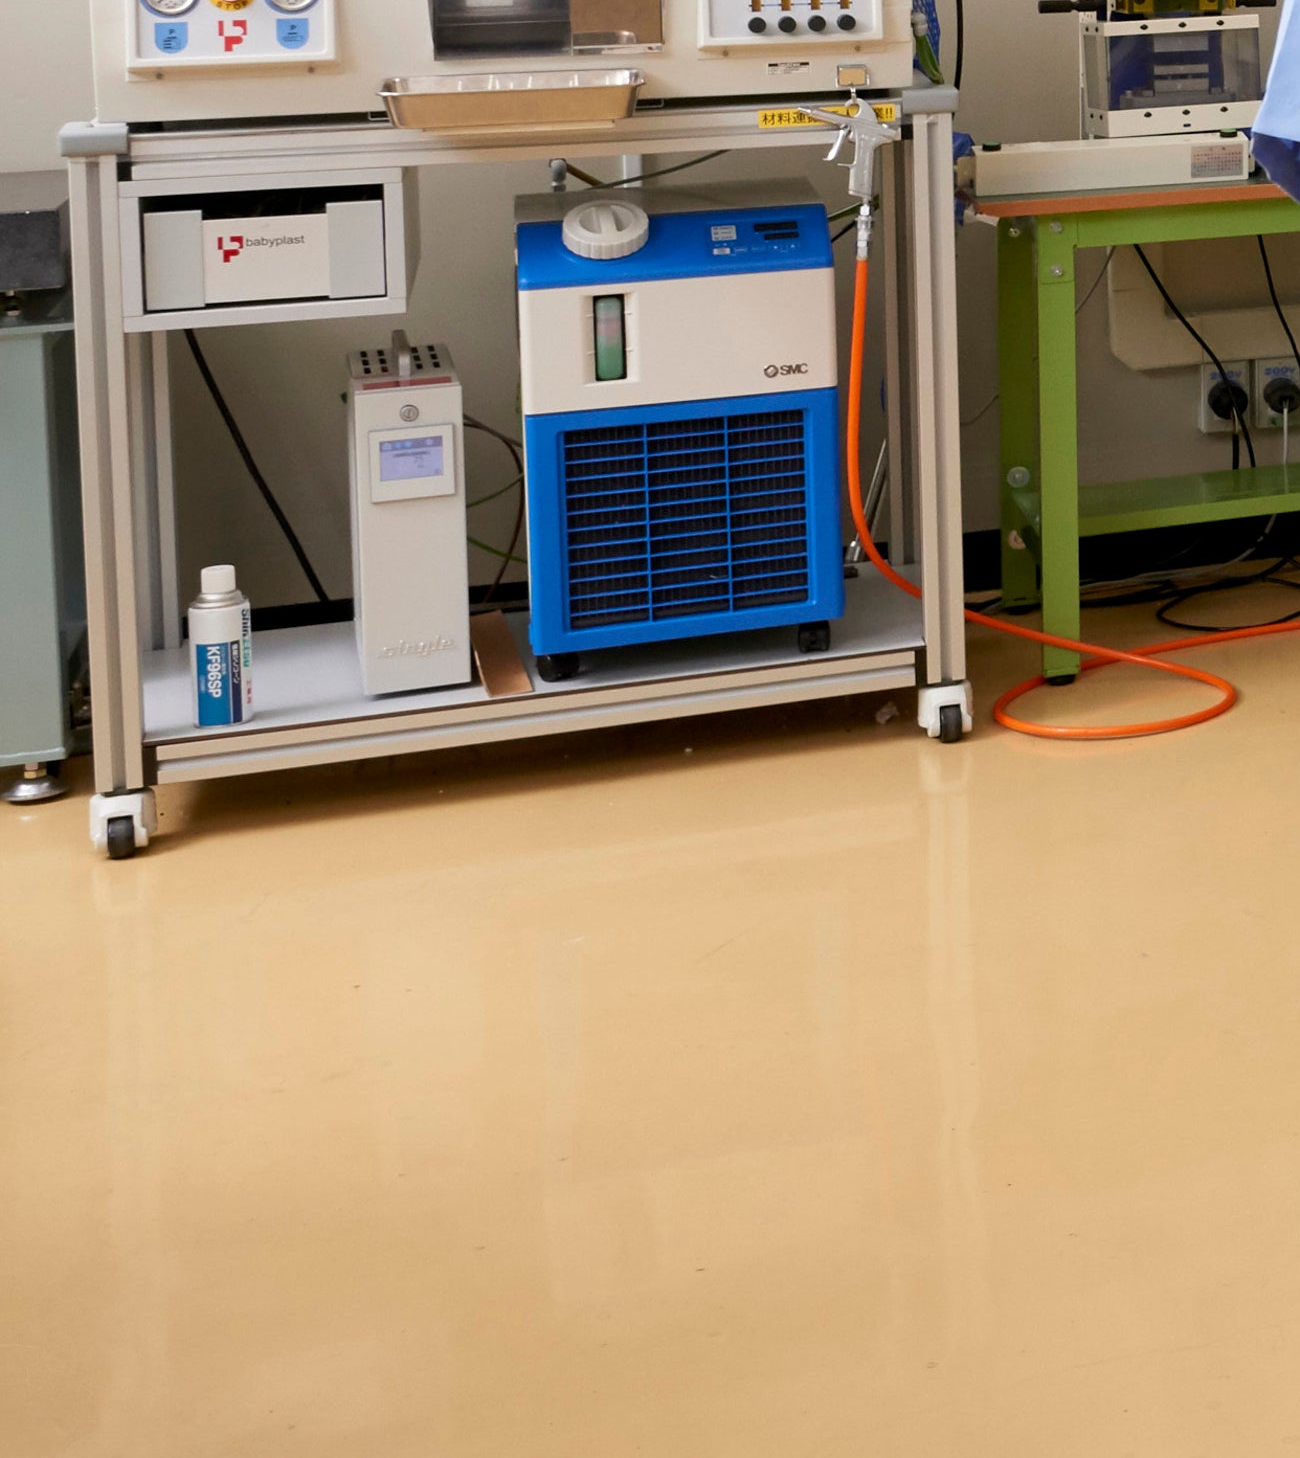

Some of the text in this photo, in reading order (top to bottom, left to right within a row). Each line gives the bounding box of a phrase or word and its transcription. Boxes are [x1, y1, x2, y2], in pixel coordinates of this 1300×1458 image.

[245, 235, 305, 248] babyplast
[780, 363, 808, 376] SMC
[206, 645, 222, 698] KF96SP
